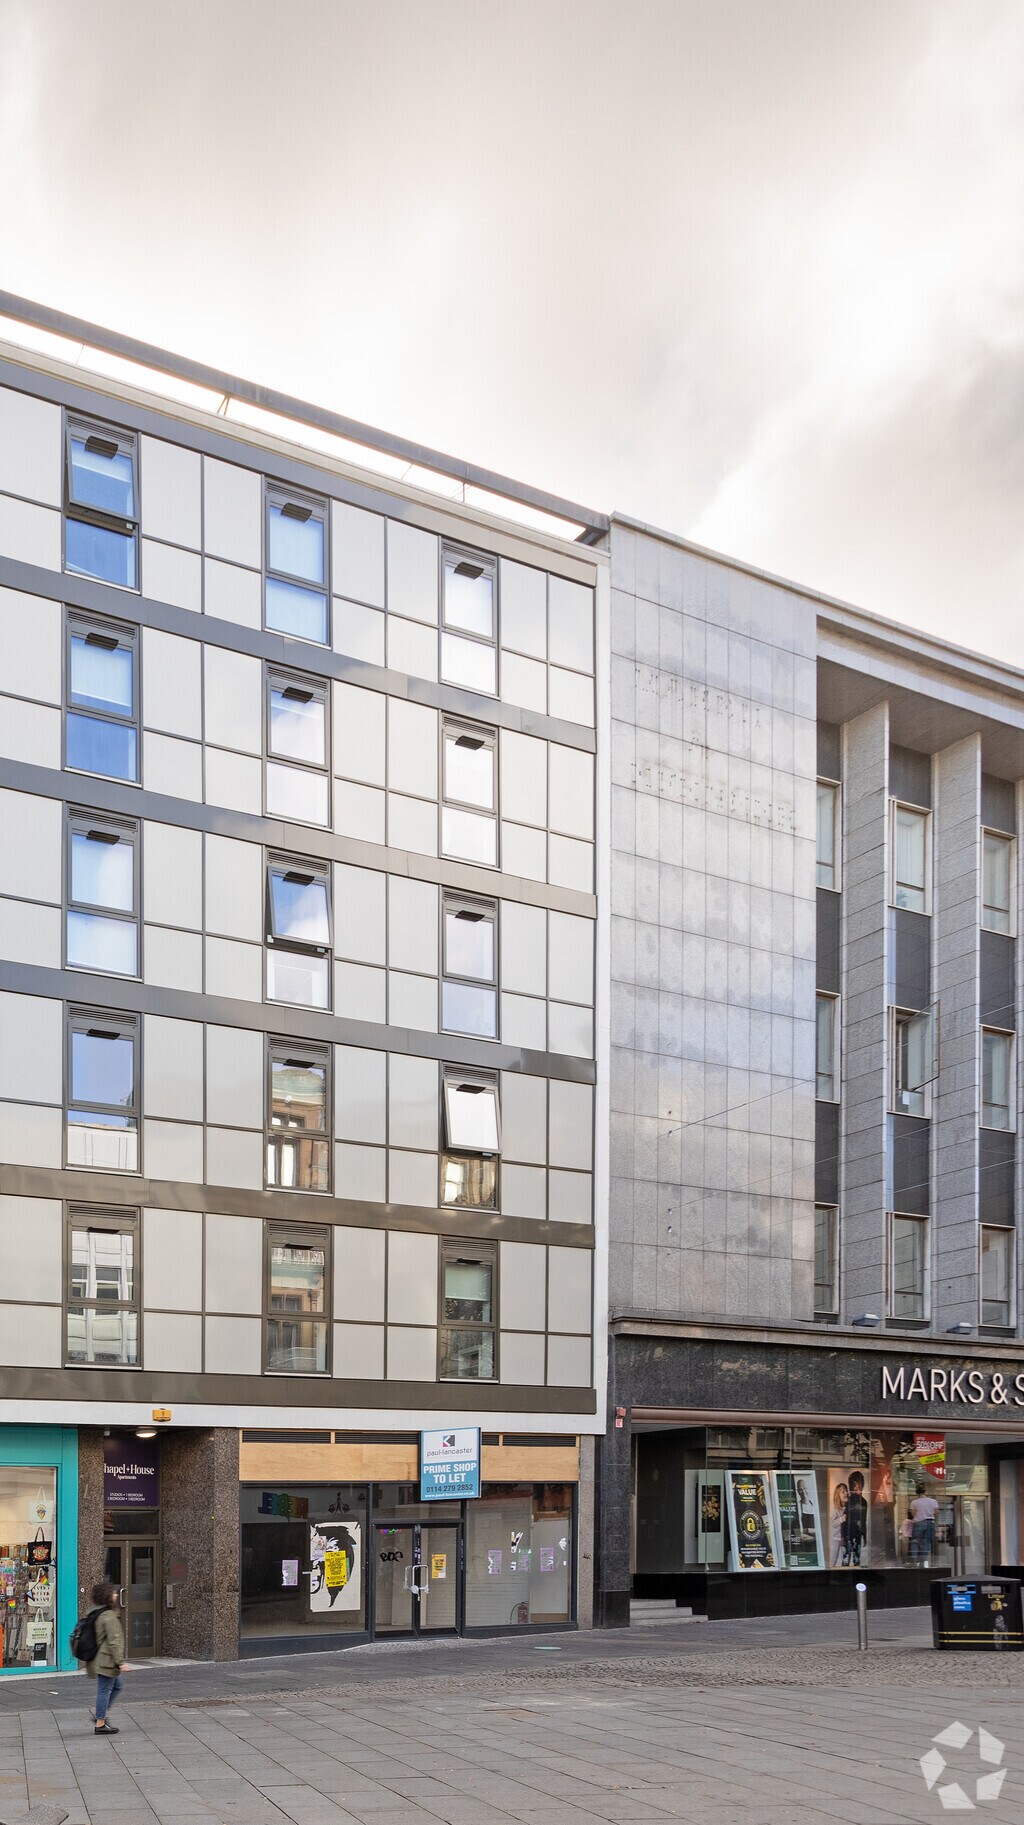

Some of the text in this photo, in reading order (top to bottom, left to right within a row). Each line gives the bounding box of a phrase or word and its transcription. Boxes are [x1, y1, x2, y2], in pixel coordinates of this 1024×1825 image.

[882, 1365, 985, 1404] MARKS
[990, 1372, 1009, 1405] &
[916, 1441, 944, 1450] 50% OFF
[103, 1463, 155, 1477] hapel House
[424, 1463, 477, 1474] PRIME SHOP
[433, 1472, 466, 1483] TO LET
